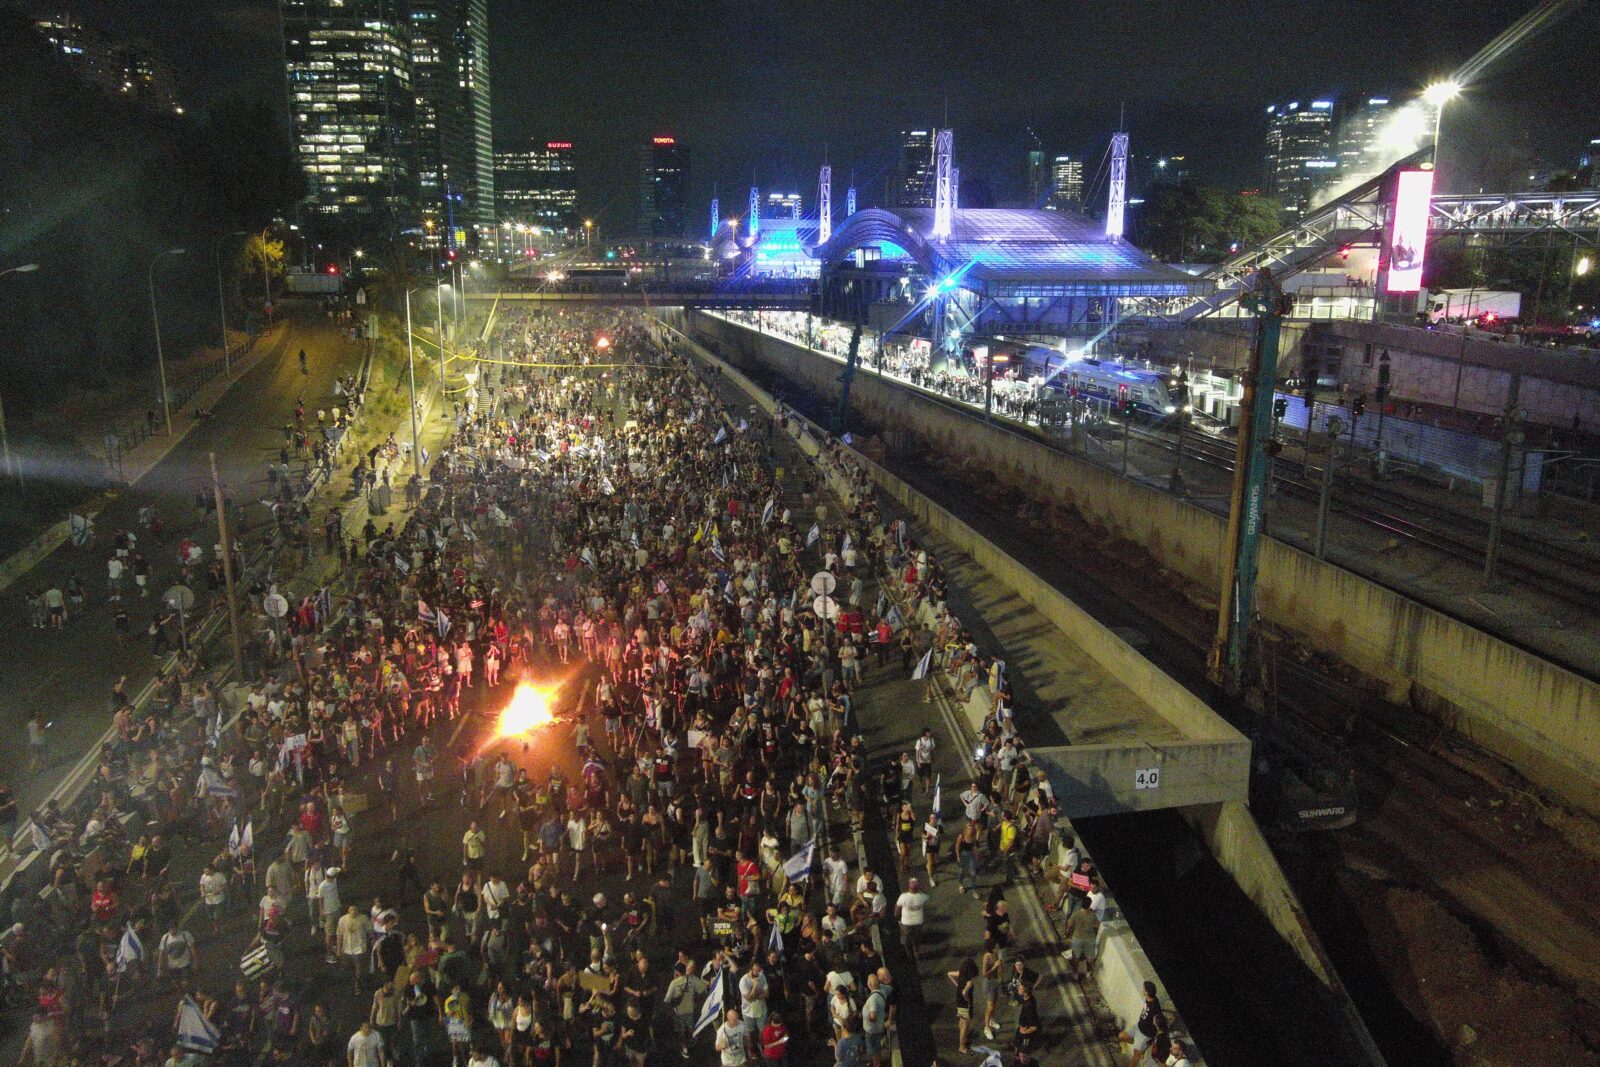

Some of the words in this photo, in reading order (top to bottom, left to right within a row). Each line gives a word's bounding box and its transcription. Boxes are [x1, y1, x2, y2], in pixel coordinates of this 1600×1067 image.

[1248, 485, 1260, 536] SUNWARD
[1137, 772, 1158, 785] 4.0
[1299, 807, 1345, 818] SUNWARD
